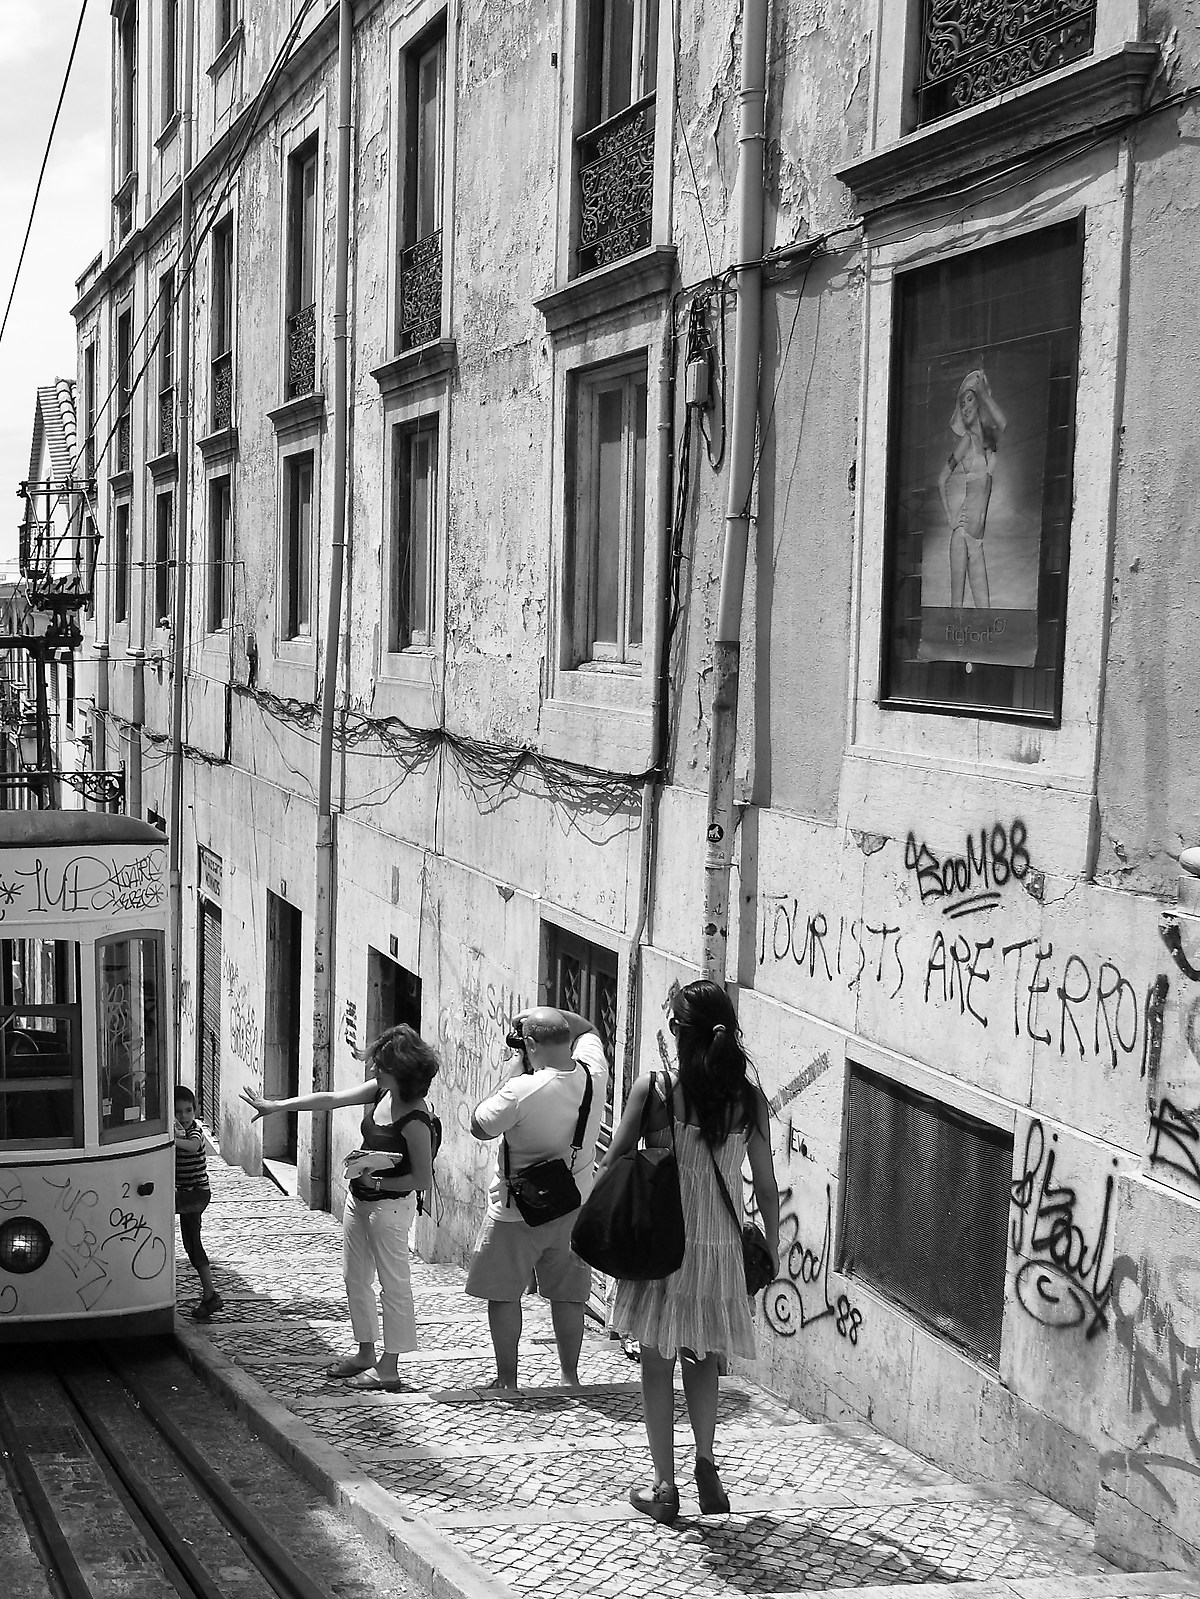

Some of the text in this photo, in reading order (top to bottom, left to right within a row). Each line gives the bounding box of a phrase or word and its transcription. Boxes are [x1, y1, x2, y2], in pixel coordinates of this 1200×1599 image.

[759, 893, 903, 1000] TOURISTS
[925, 930, 995, 1028] ARE
[121, 1182, 131, 1199] 2
